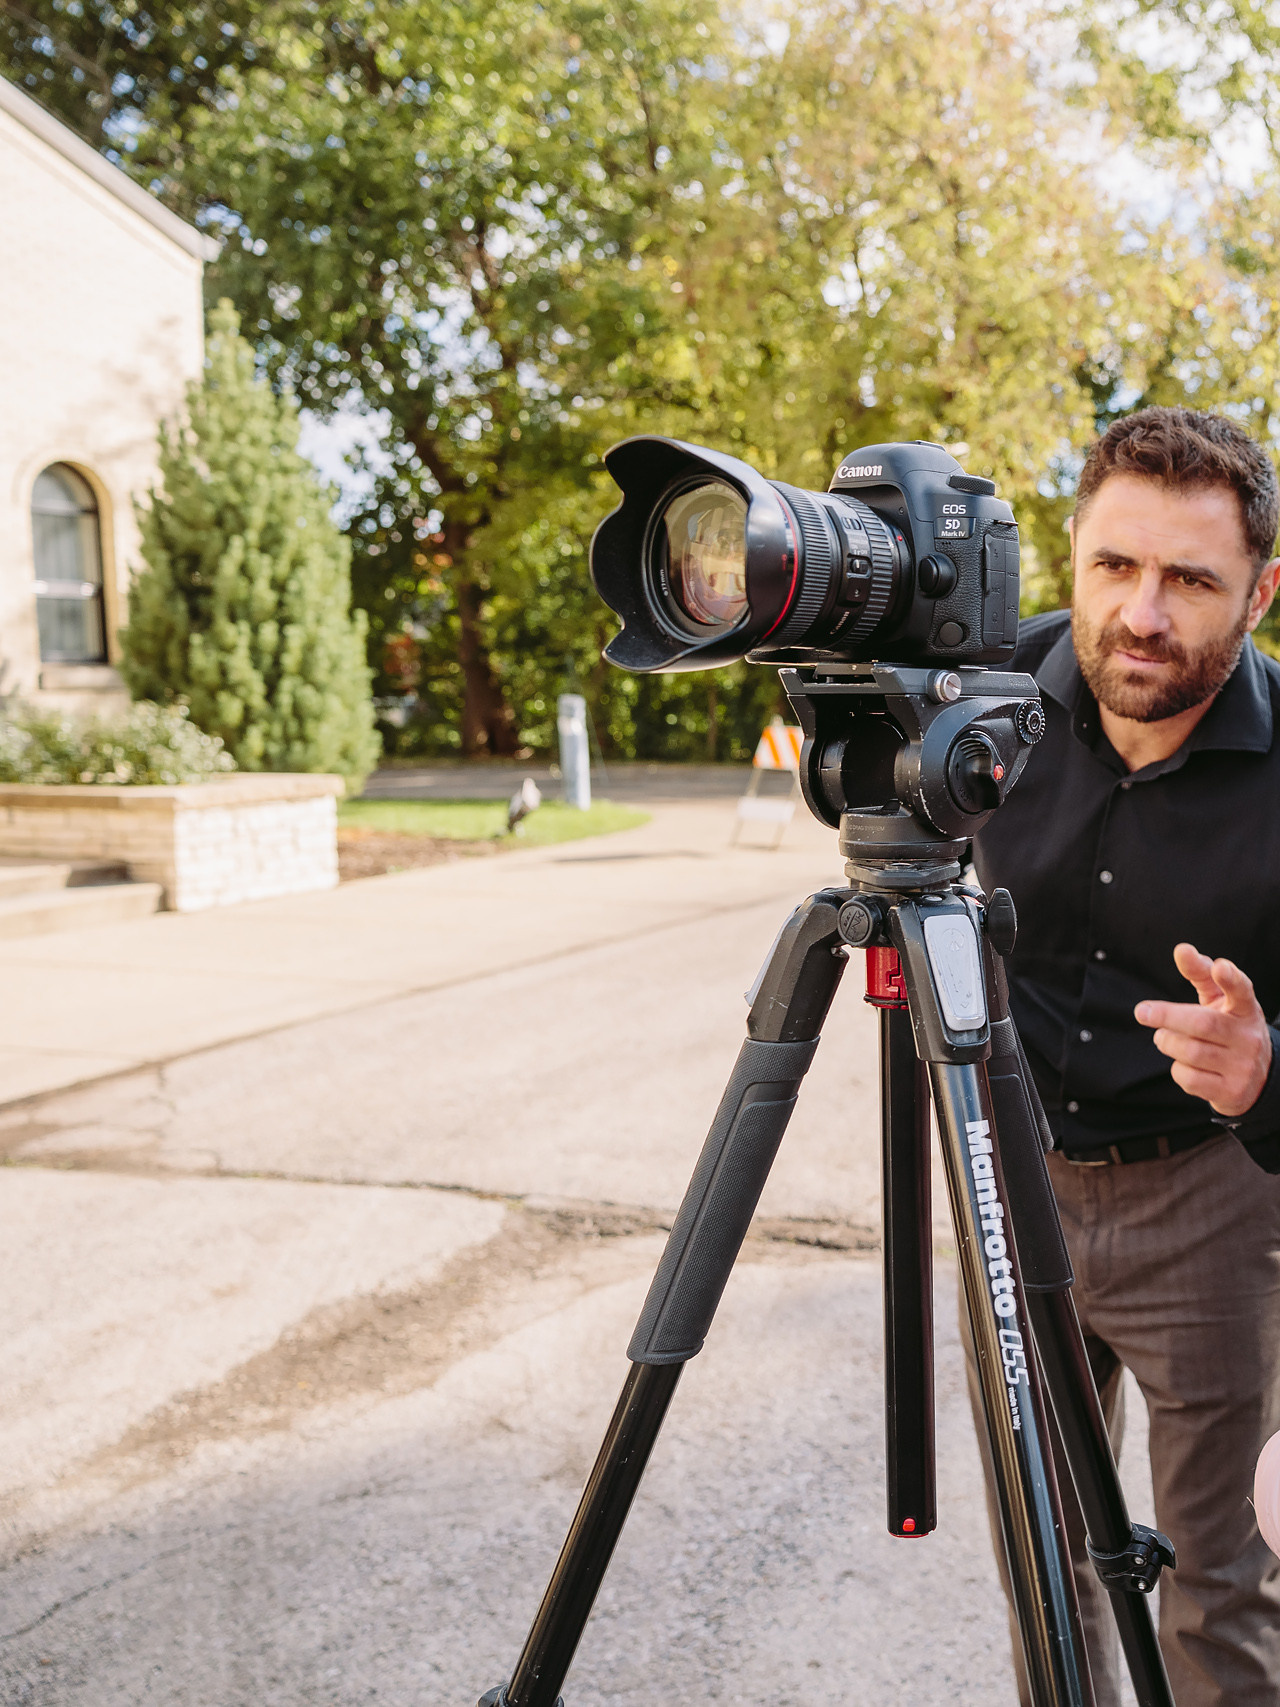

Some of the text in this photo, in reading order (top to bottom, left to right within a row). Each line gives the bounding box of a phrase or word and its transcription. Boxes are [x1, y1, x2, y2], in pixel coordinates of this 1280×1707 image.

[837, 464, 883, 479] Canon
[942, 504, 967, 514] EOS
[944, 519, 961, 530] 5D
[965, 1119, 1030, 1386] Manfrotto 055
[1008, 1387, 1018, 1407] made
[1012, 1406, 1019, 1415] in
